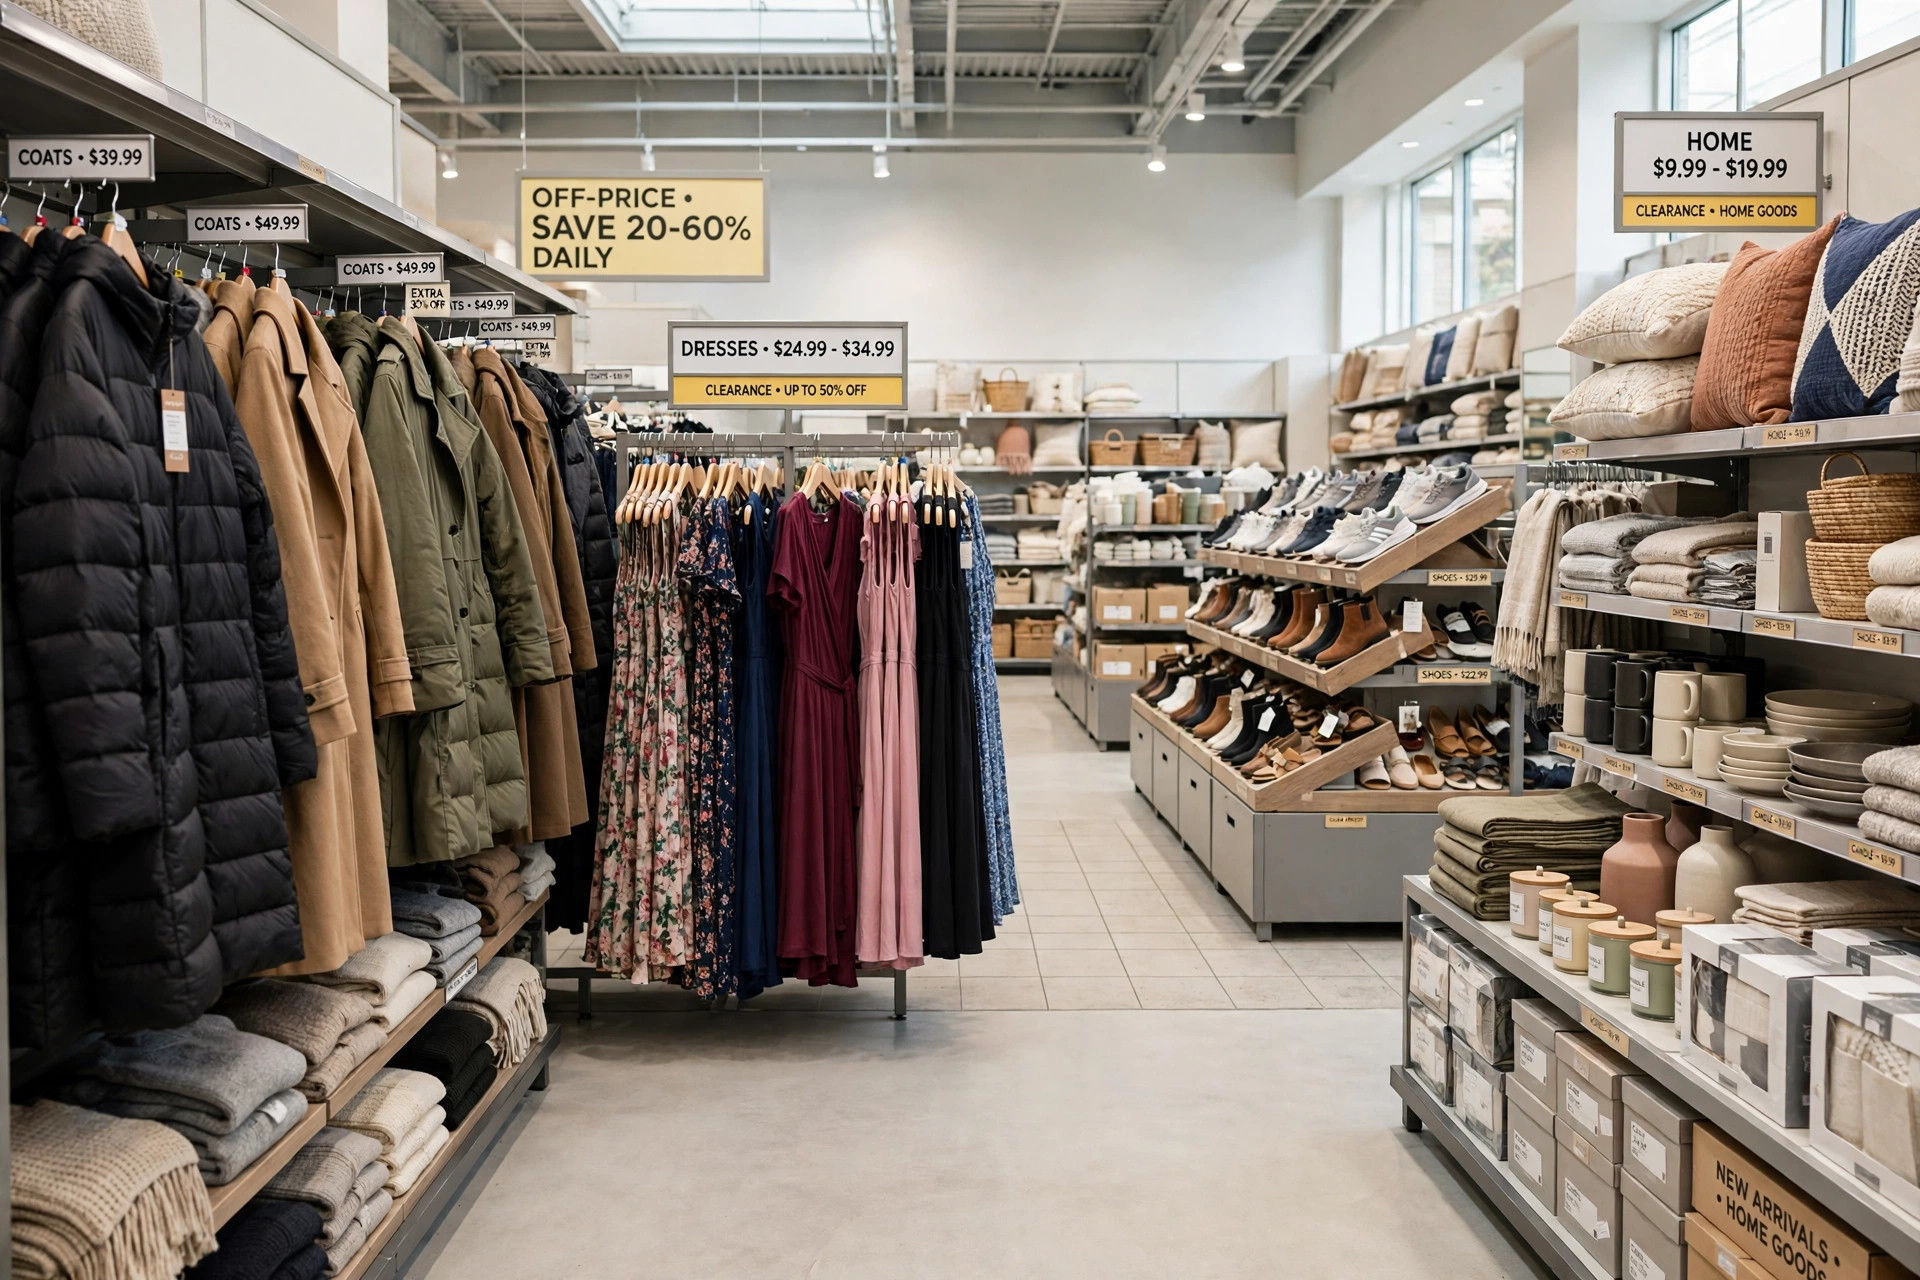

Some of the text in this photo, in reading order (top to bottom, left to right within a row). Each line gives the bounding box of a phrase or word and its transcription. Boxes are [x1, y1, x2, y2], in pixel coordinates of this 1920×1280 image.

[1687, 131, 1753, 152] HOME
[17, 147, 143, 166] COATS $39.99
[1653, 156, 1707, 180] $9.99
[1725, 156, 1788, 180] $19.99
[532, 187, 676, 209] OFF-PRICE
[1635, 204, 1798, 218] CLEARANCE HOME GOODS
[194, 214, 300, 232] COATS $49.99
[532, 214, 752, 241] SAVE 20-60%
[533, 246, 614, 269] DAILY
[342, 261, 436, 276] COATS $49.99
[411, 287, 444, 298] EXTRA
[429, 299, 446, 310] OFF
[474, 299, 509, 311] $49.99
[480, 321, 552, 333] COATS $49.99
[681, 340, 759, 357] DRESSES
[773, 339, 827, 358] $24.99
[842, 339, 895, 358] $34.99
[705, 383, 867, 397] CLEARANCE UP TO 50% OFF
[1432, 573, 1458, 582] SHOES
[1422, 670, 1453, 680] SHOES
[1716, 1159, 1829, 1264] NEW ARRIVALS
[1726, 1195, 1768, 1247] HOME
